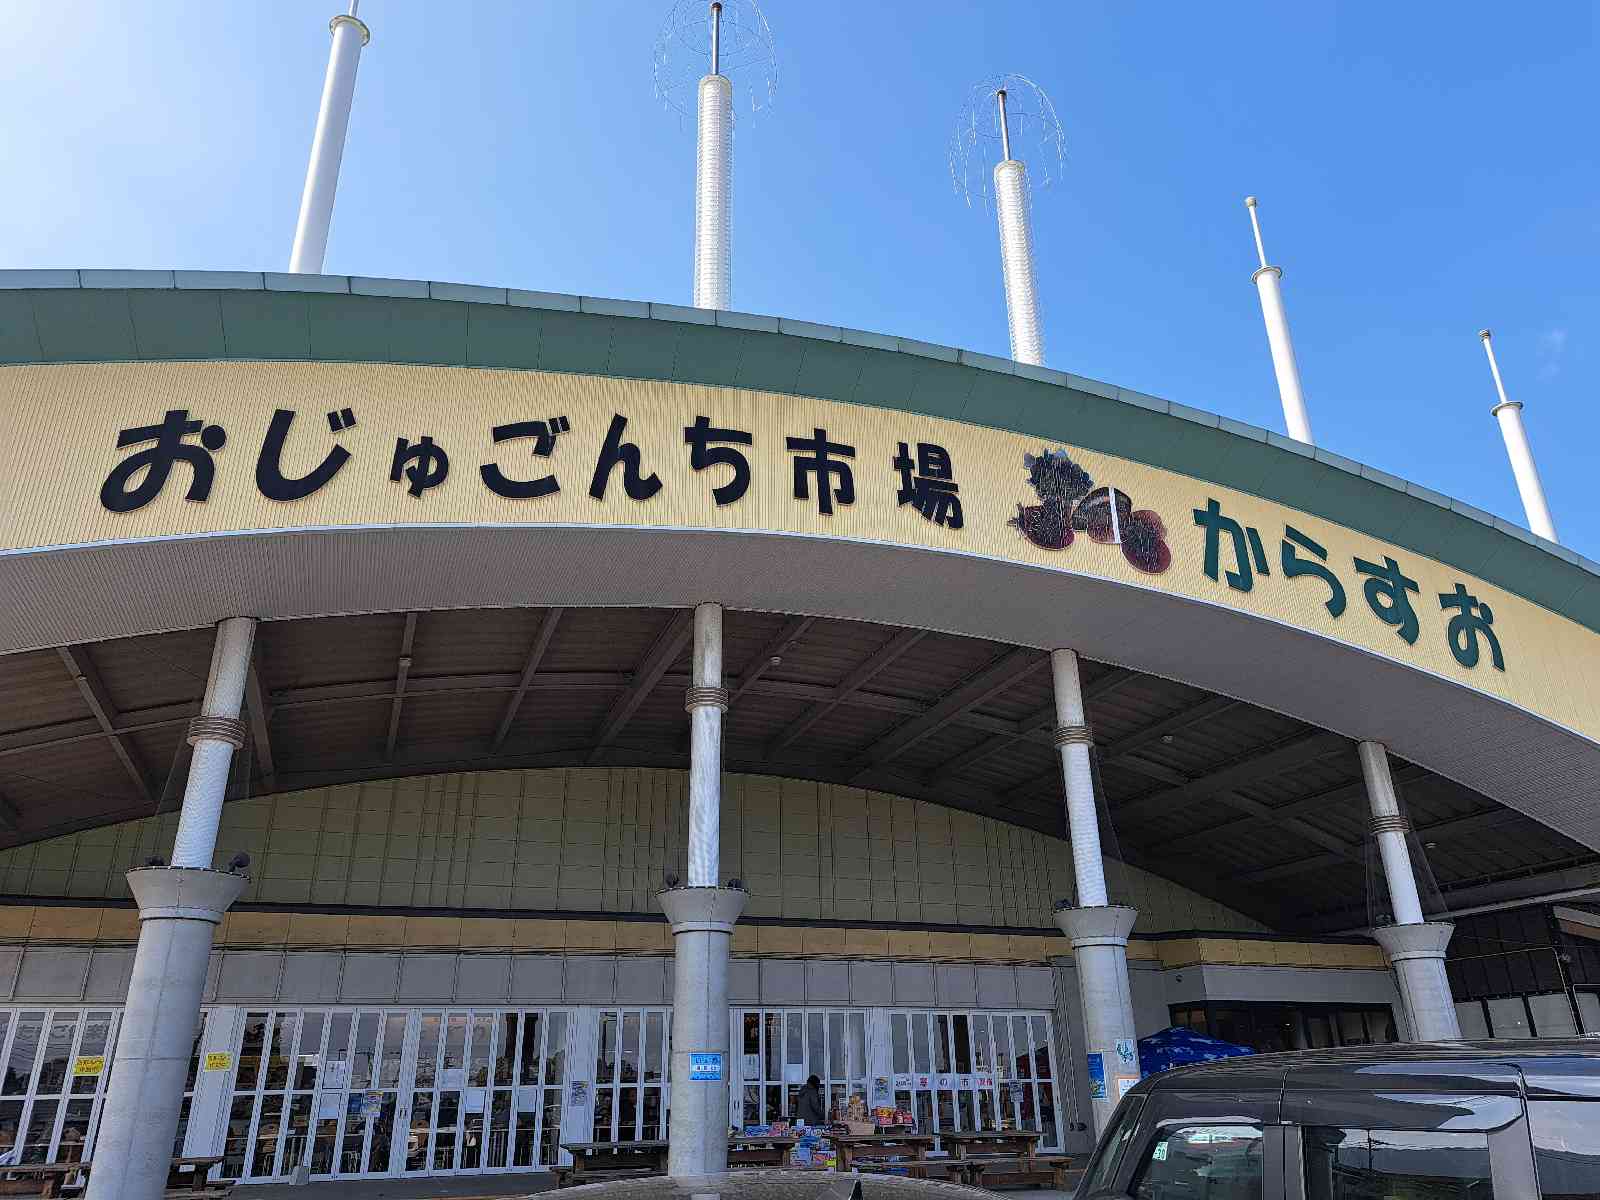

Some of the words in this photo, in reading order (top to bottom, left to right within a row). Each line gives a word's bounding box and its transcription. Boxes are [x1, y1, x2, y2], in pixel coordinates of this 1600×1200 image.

[99, 407, 964, 529] おじゅごんち市場
[1192, 497, 1505, 673] からすお
